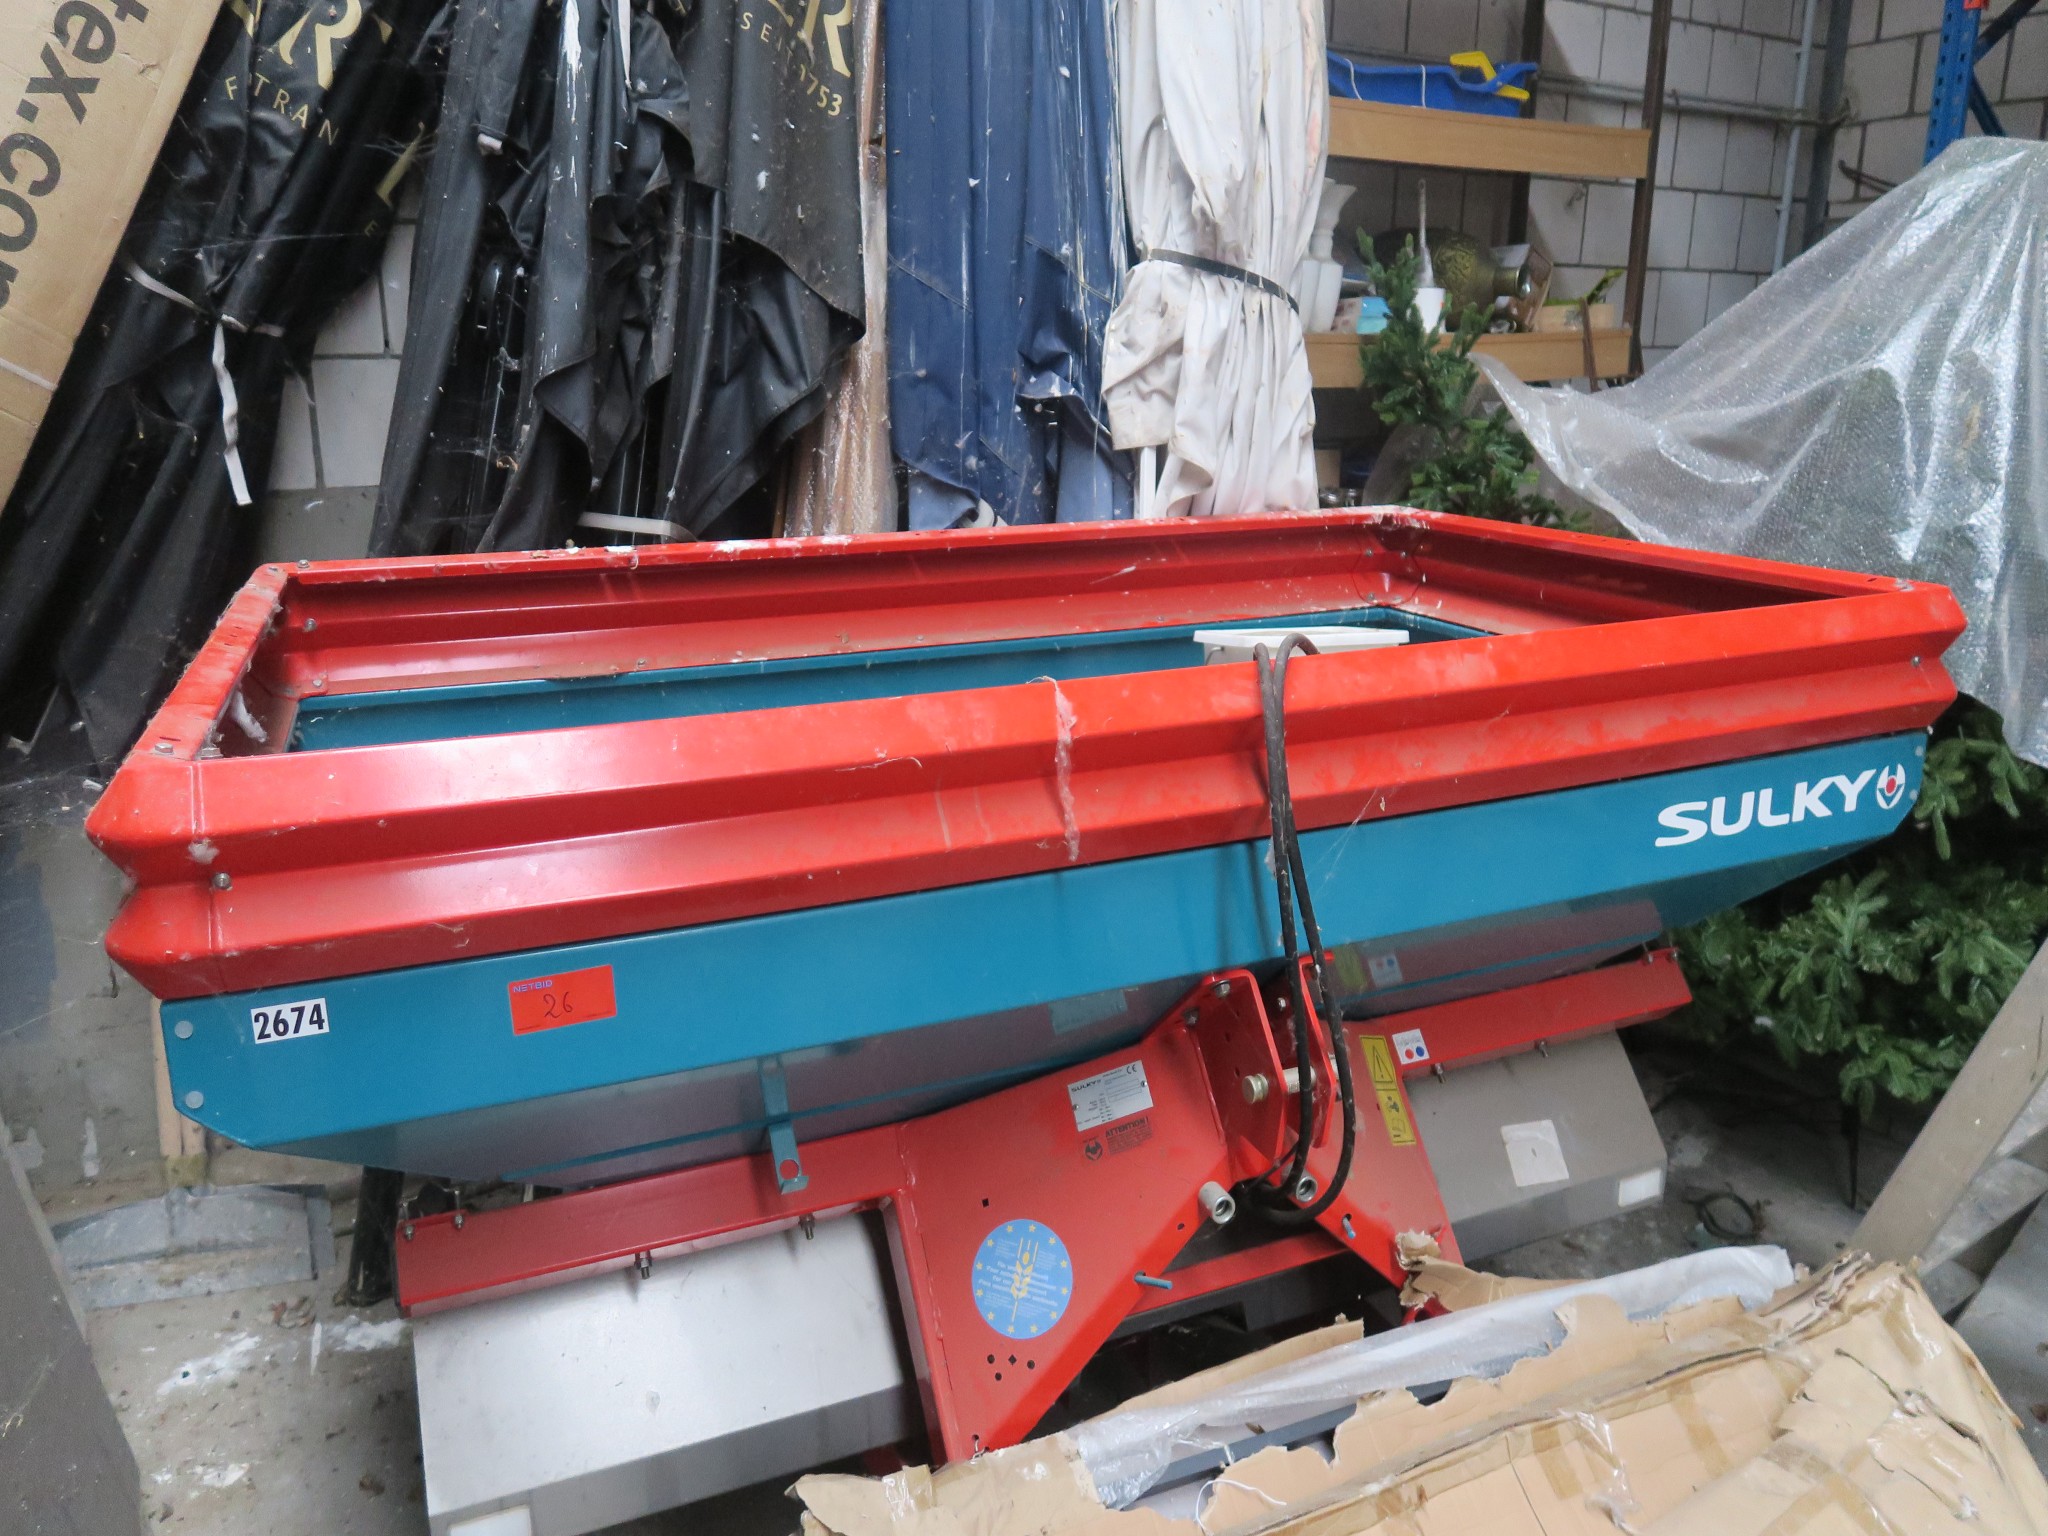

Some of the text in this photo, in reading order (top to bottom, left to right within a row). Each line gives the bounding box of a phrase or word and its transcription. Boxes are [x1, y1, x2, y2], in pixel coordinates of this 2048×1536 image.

[799, 63, 843, 117] 1753
[1655, 768, 1877, 847] SULKY
[513, 979, 553, 993] NETBID
[543, 992, 574, 1019] 26
[253, 1002, 326, 1041] 2674
